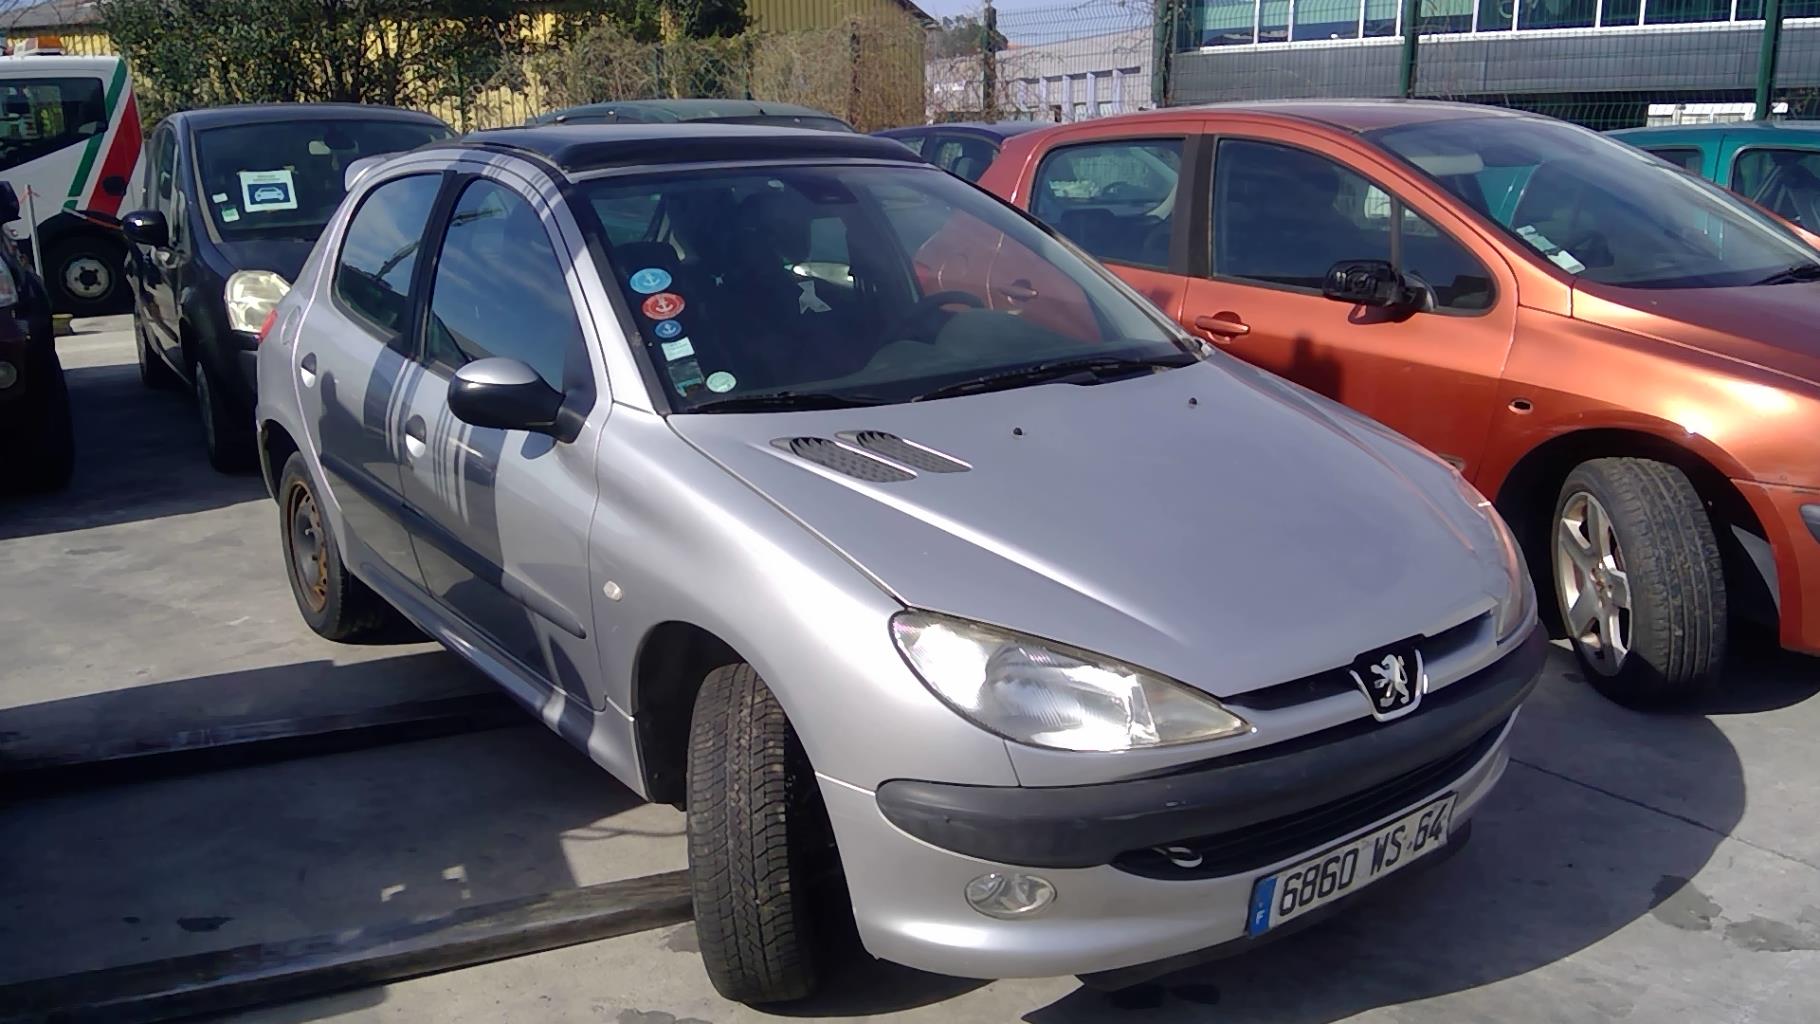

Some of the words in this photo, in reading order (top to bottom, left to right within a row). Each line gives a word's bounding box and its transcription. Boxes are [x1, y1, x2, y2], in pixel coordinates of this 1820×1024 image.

[1279, 847, 1360, 917] 6860
[1370, 824, 1405, 876] WS
[1413, 802, 1449, 852] 64
[1255, 909, 1266, 925] F
